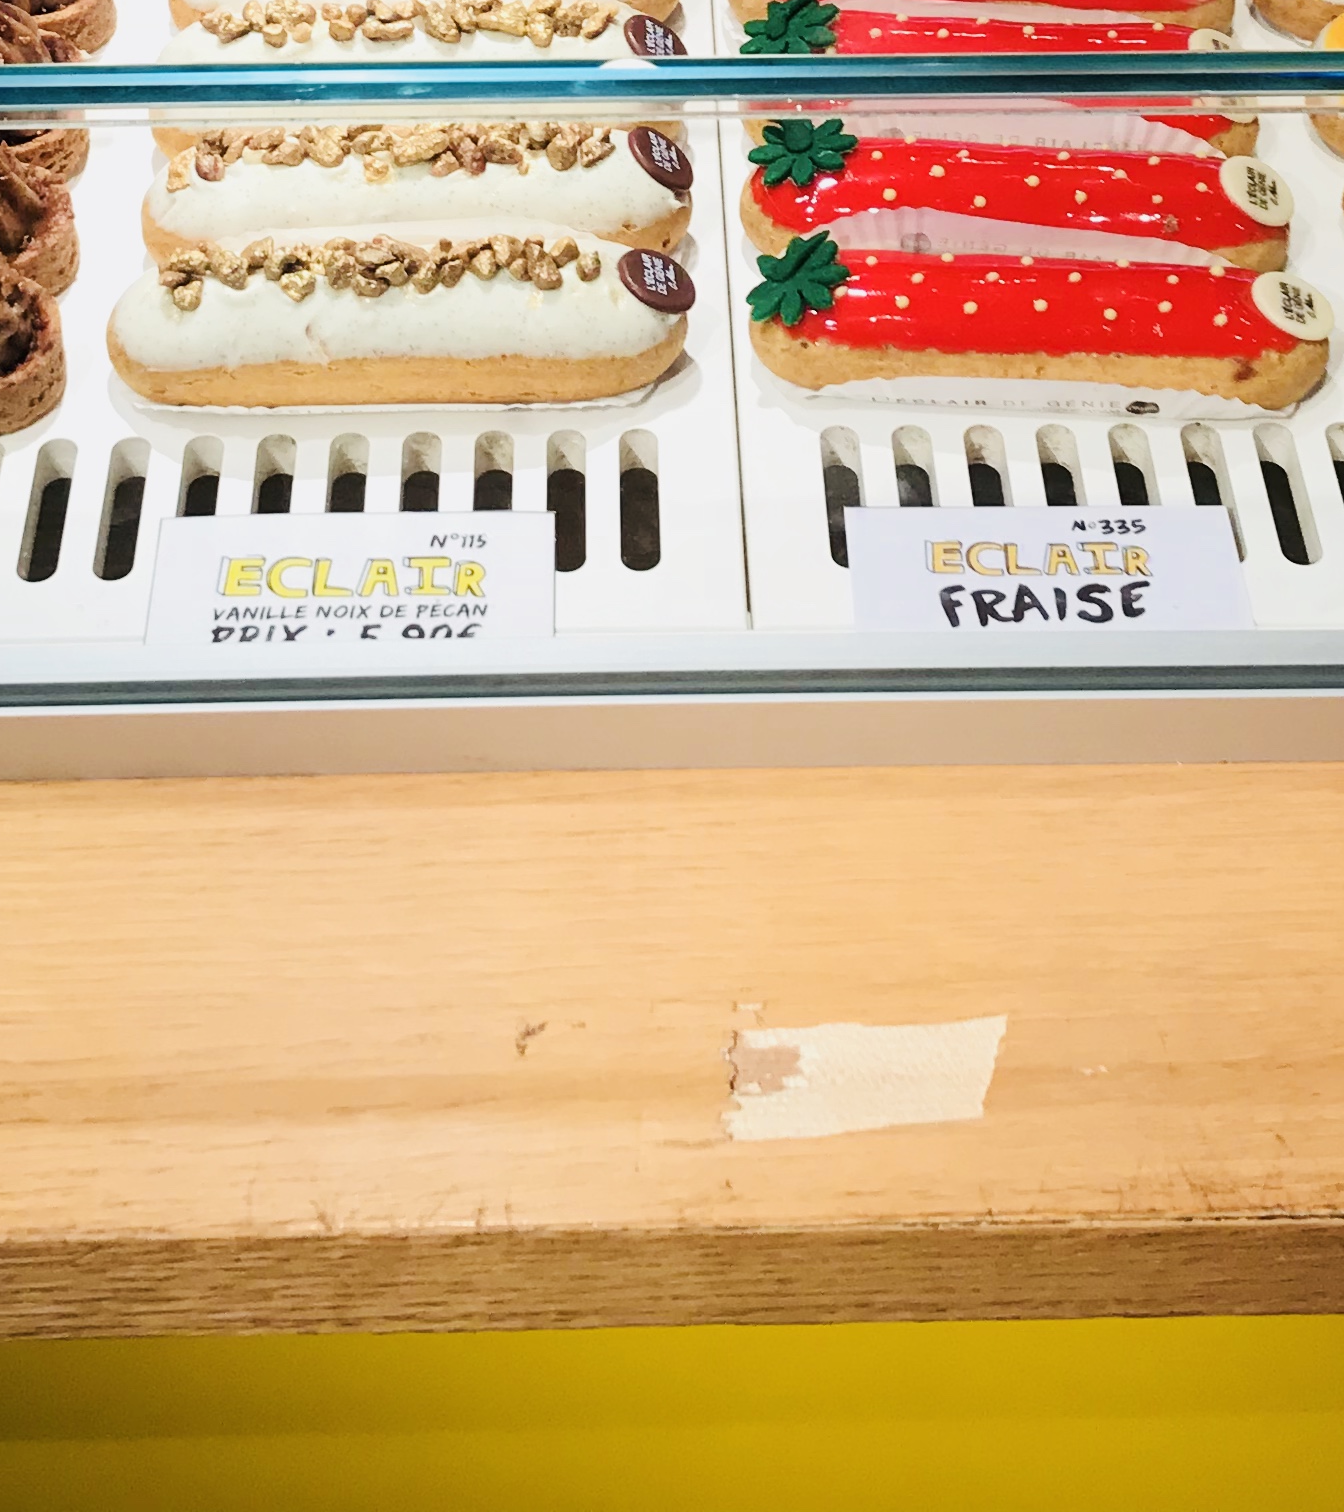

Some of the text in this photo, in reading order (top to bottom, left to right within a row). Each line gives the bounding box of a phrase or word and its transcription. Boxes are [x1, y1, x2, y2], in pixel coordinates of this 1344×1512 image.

[430, 533, 487, 550] N°115
[924, 540, 1153, 577] ECLAIR
[218, 555, 487, 599] ECLAIR
[212, 605, 307, 621] VANILLE
[315, 604, 372, 620] NOIX
[379, 604, 408, 618] DE
[939, 580, 1152, 628] FRAISE
